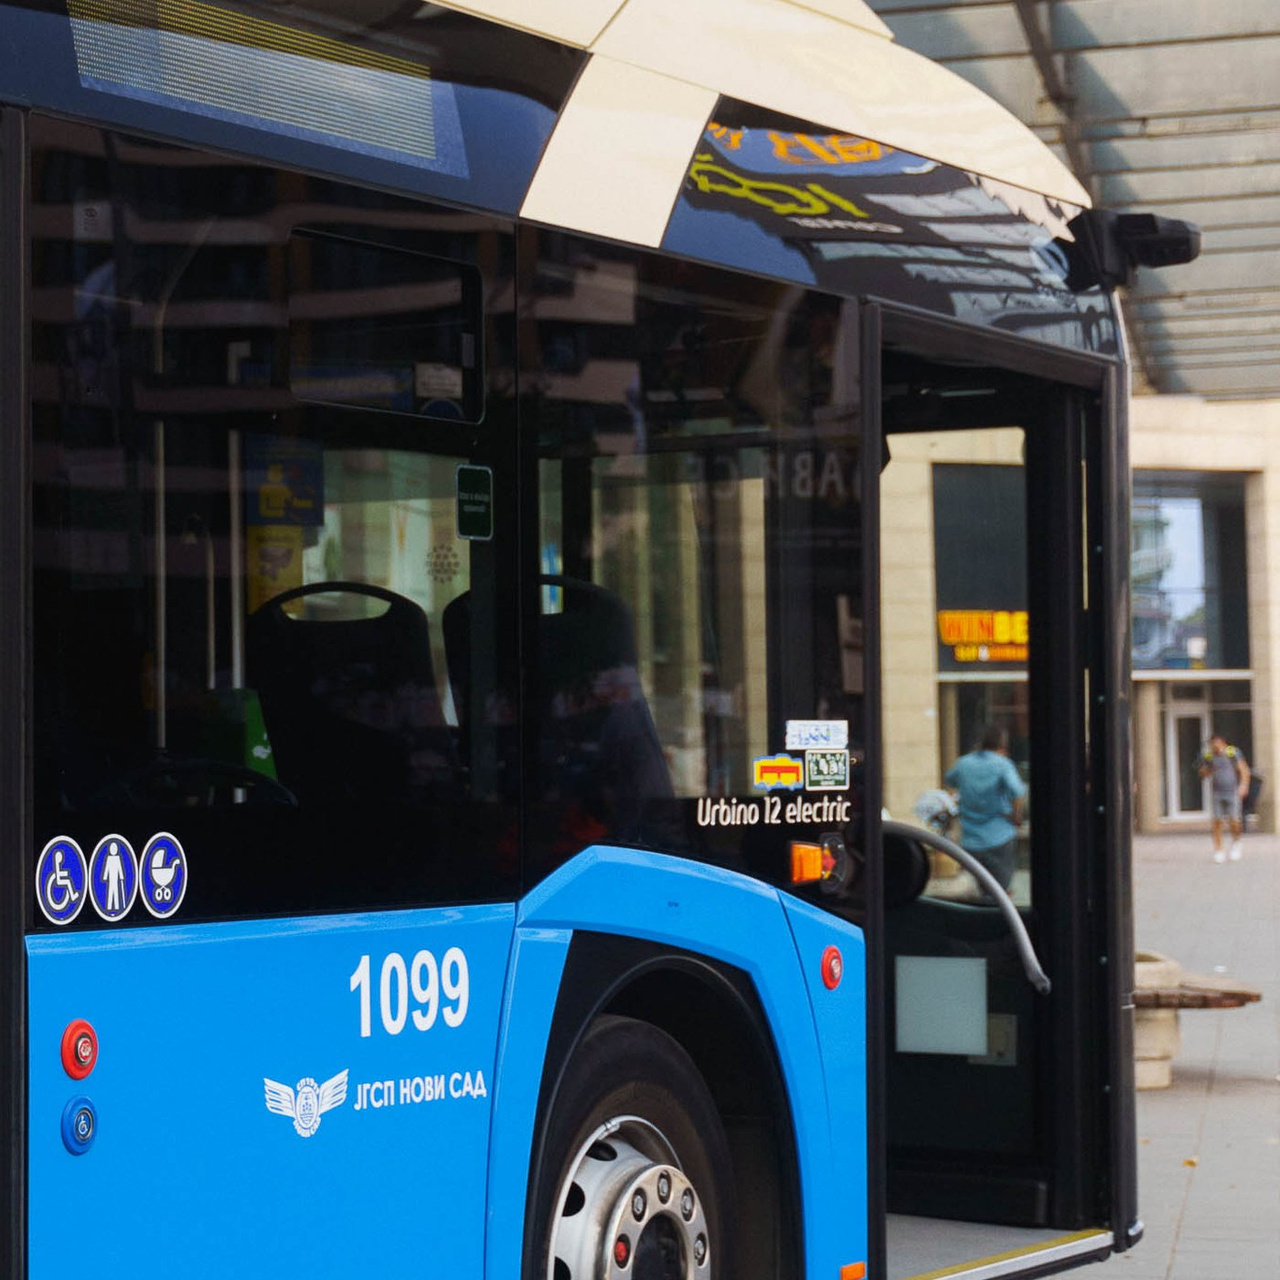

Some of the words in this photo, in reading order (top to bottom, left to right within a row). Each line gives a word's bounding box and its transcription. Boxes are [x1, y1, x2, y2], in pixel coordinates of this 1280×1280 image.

[938, 610, 1028, 645] WINBE
[697, 796, 760, 826] Urbino
[764, 795, 781, 825] 12
[785, 794, 851, 824] electric
[349, 945, 470, 1038] 1099
[353, 1080, 395, 1111] ЈГСП
[399, 1074, 445, 1105] НОВИ
[449, 1070, 487, 1099] САД
